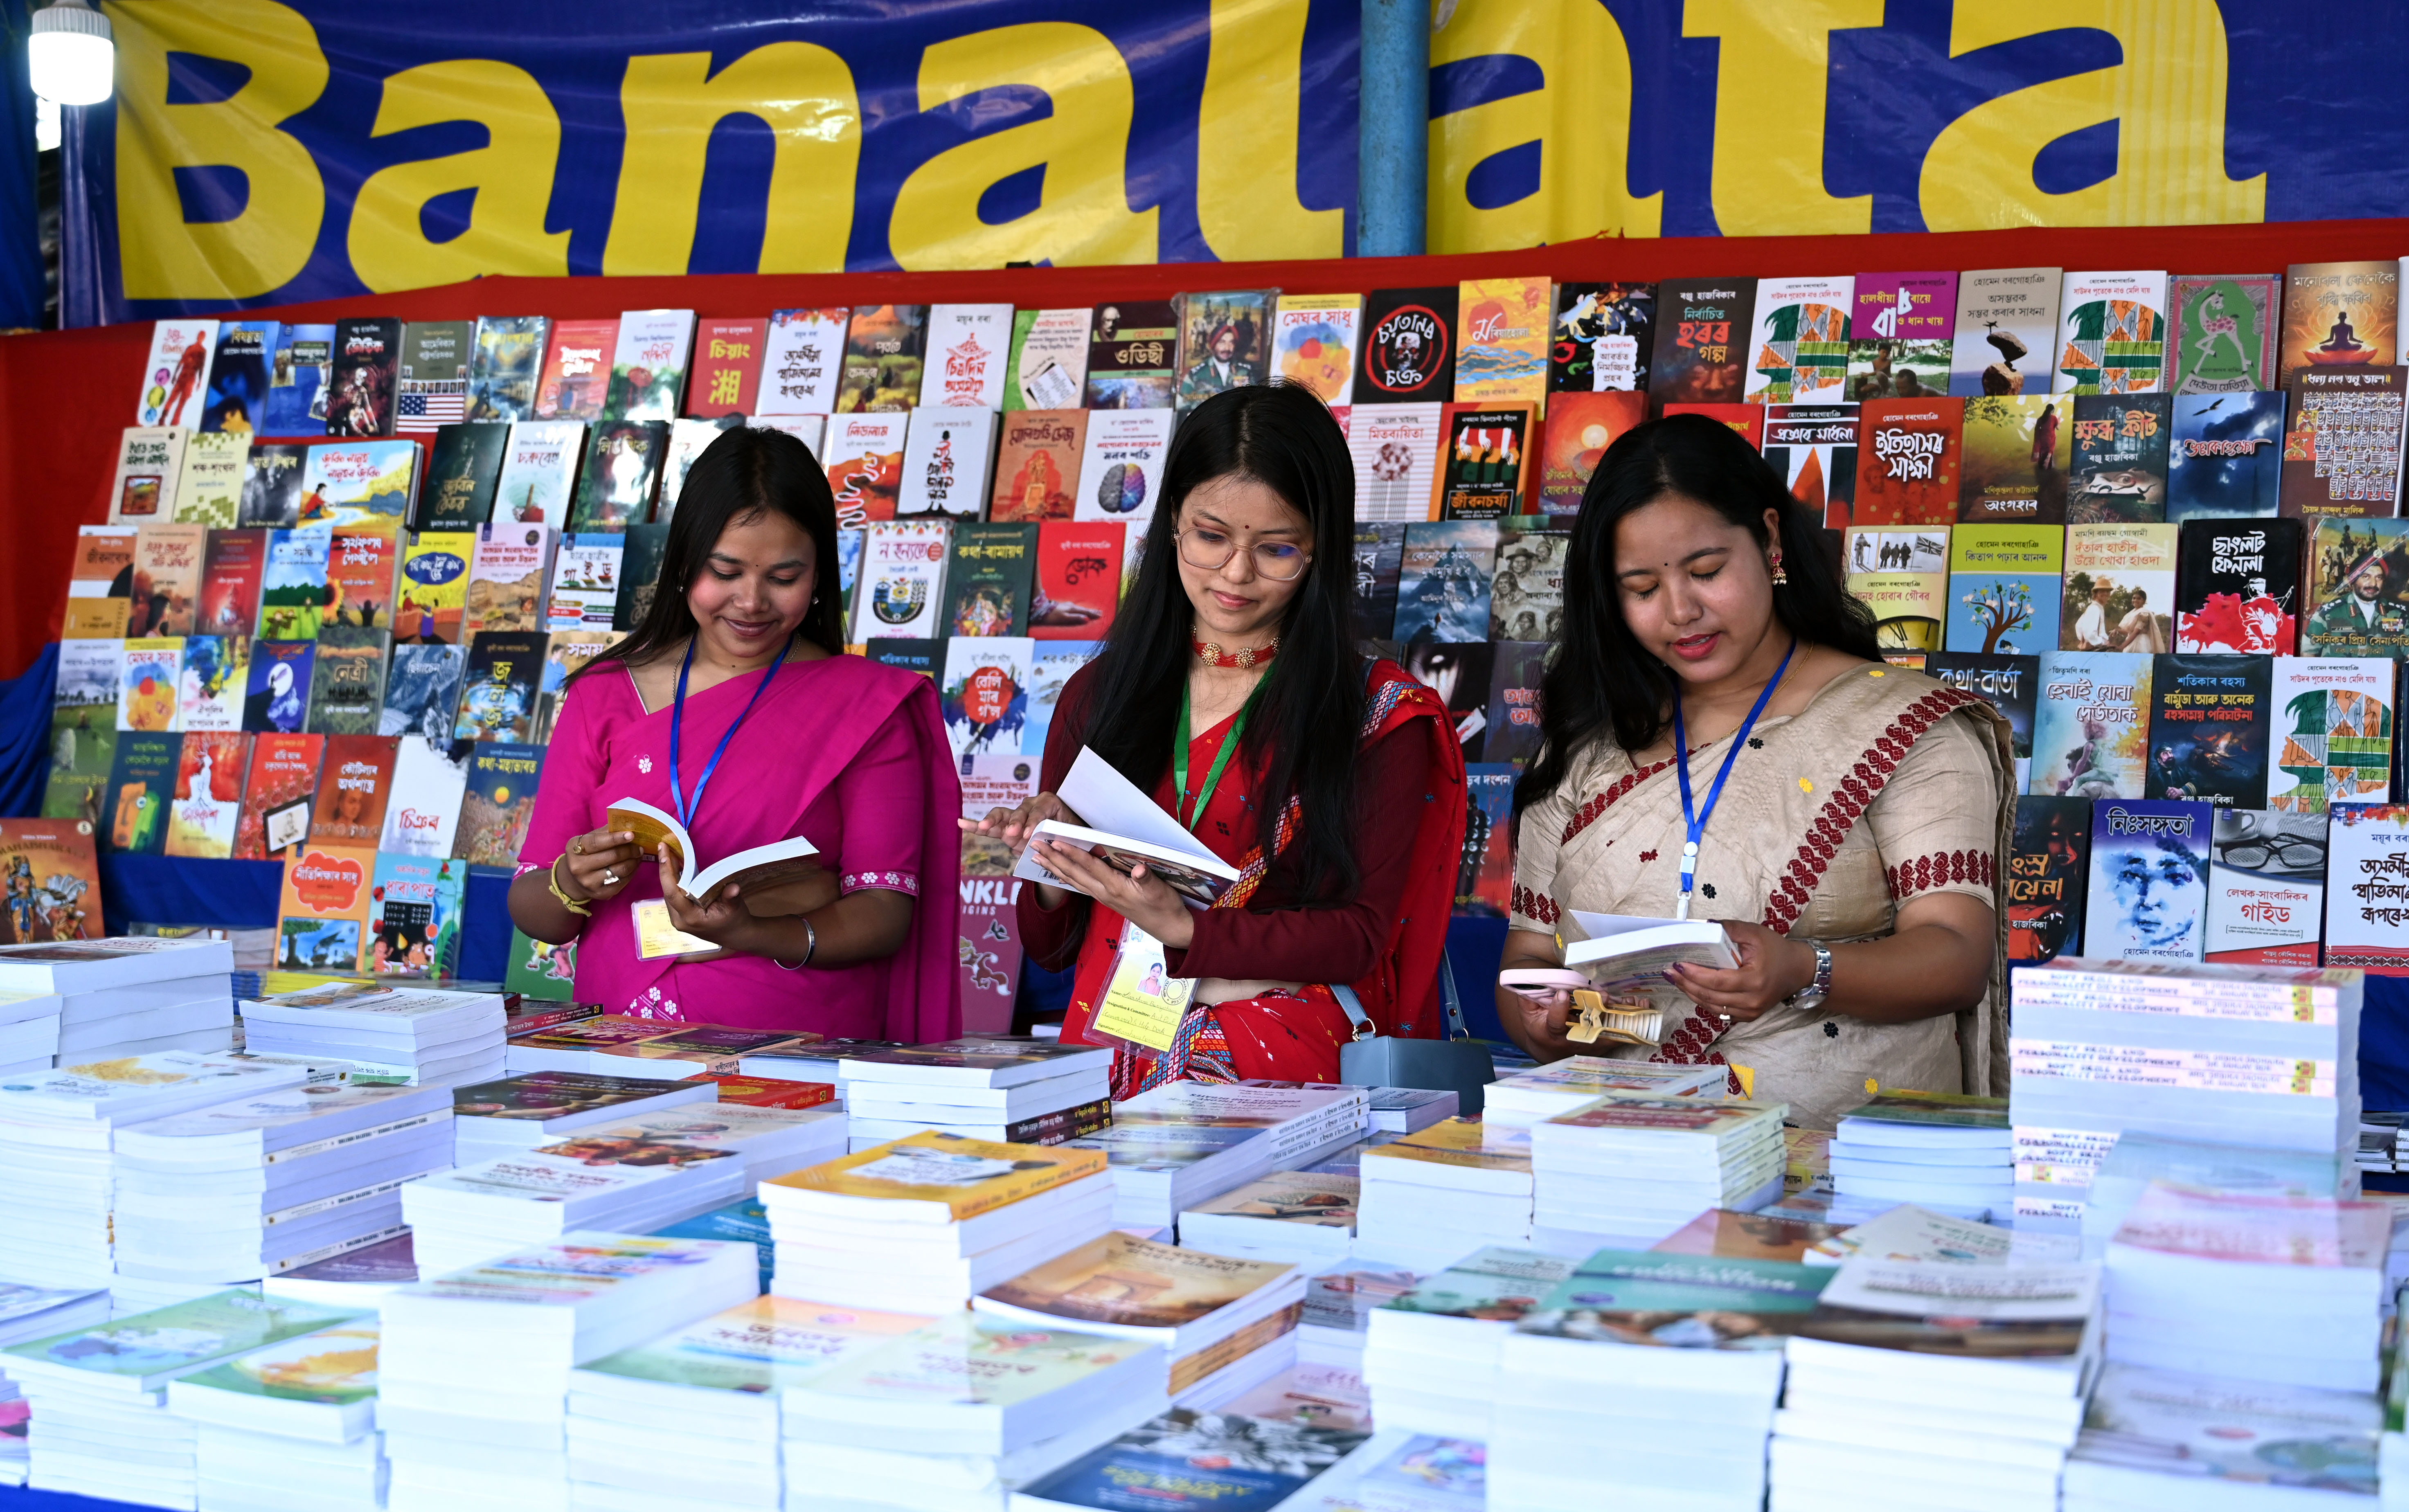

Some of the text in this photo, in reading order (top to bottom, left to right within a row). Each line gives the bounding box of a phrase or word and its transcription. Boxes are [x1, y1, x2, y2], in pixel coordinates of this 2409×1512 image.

[1974, 274, 2045, 287] হোমেন বৰগোহাঞি
[2019, 307, 2045, 317] সাধনা
[1283, 309, 1353, 328] মেঘৰ সাধু
[1908, 317, 1923, 326] ধান
[2075, 529, 2094, 537] মামণি
[2001, 540, 2039, 549] বৰগোহাঞি
[1965, 550, 1994, 562] কিতাপ
[2022, 552, 2047, 562] আনন্দ
[975, 671, 1002, 688] বেলি
[2177, 674, 2217, 687] শতিকাৰ
[2349, 674, 2364, 683] মেলি
[2193, 694, 2219, 705] আৰু
[2221, 694, 2255, 705] অনেক
[2241, 900, 2291, 926] গাইড
[2012, 919, 2047, 929] হাজৰিকা
[2123, 947, 2194, 959] হোমেন বৰগোহাঞি
[1106, 1000, 1130, 1013] Designation
[1133, 1009, 1151, 1018] Committee:
[1097, 1022, 1116, 1032] Signature:
